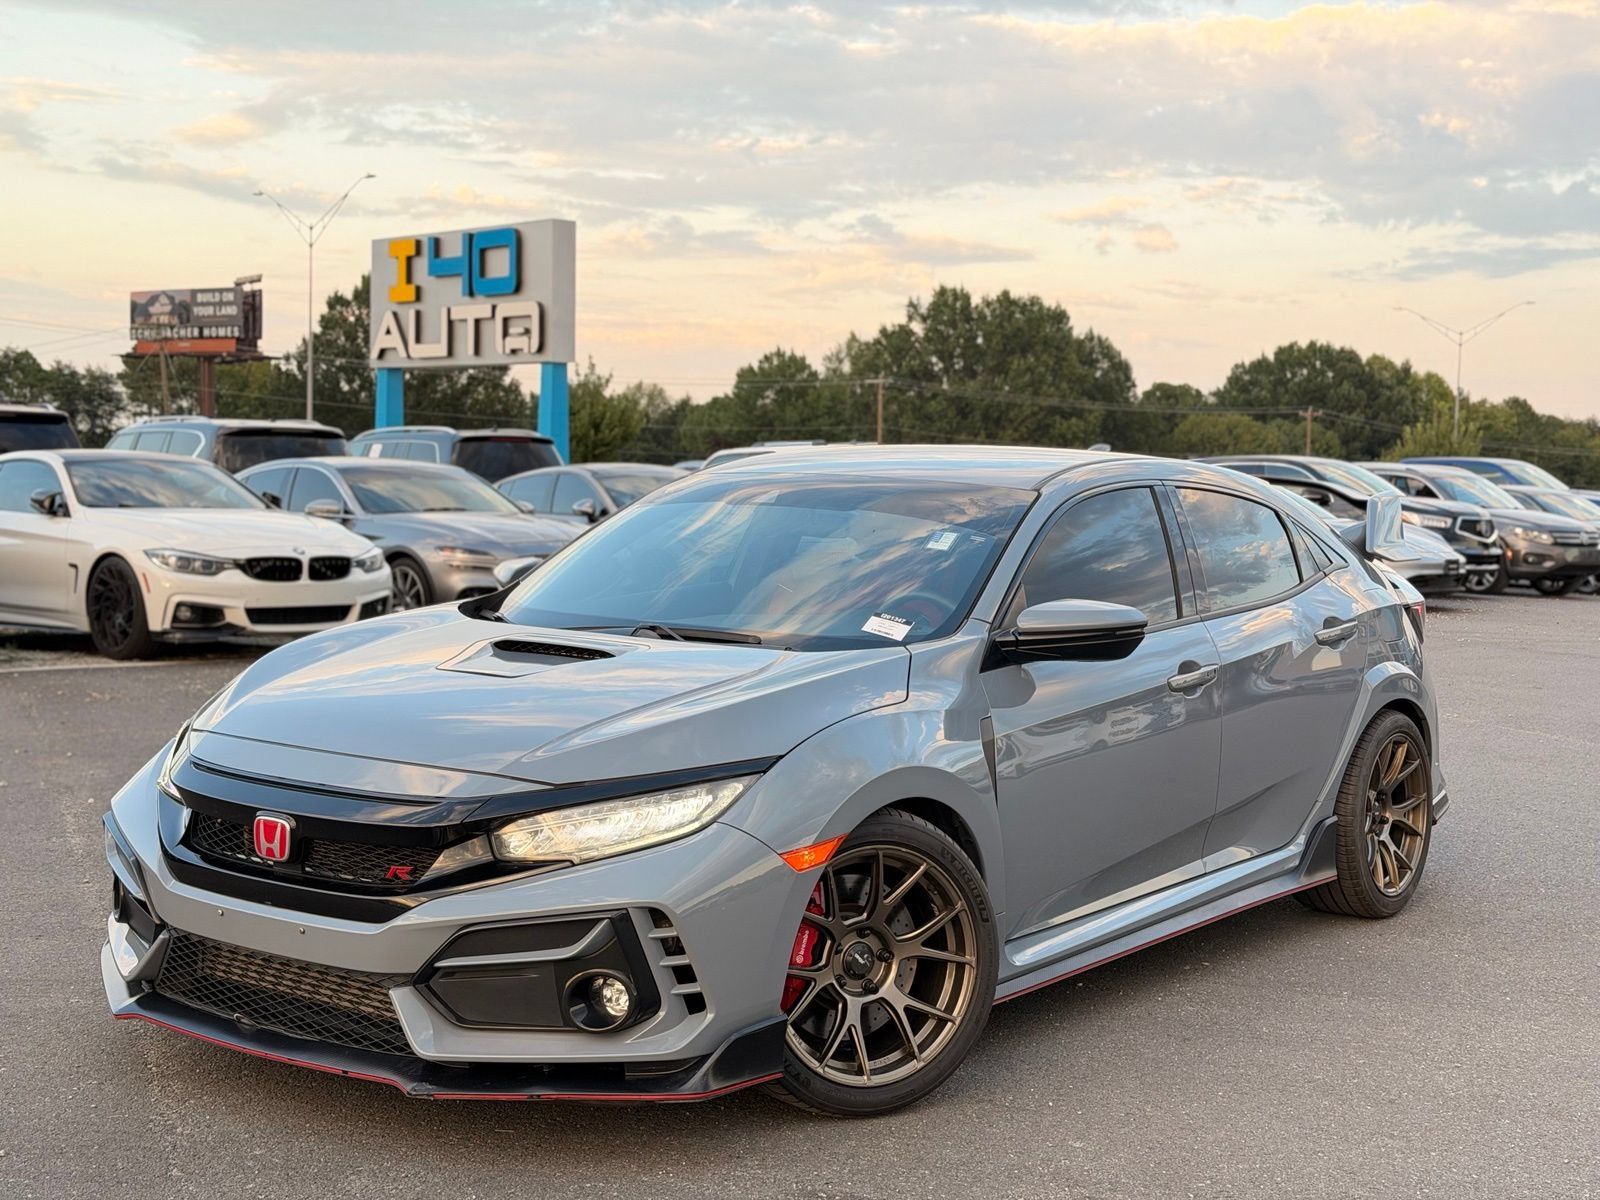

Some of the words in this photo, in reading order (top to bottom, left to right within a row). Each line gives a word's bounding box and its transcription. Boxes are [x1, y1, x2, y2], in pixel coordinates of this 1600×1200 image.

[196, 292, 220, 303] BUILD
[222, 291, 235, 302] ON
[193, 306, 215, 317] YOUR
[216, 305, 238, 316] LAND
[202, 325, 240, 338] HOMES
[371, 300, 543, 360] AUTO
[385, 865, 413, 881] R
[952, 859, 991, 924] MICHELIN
